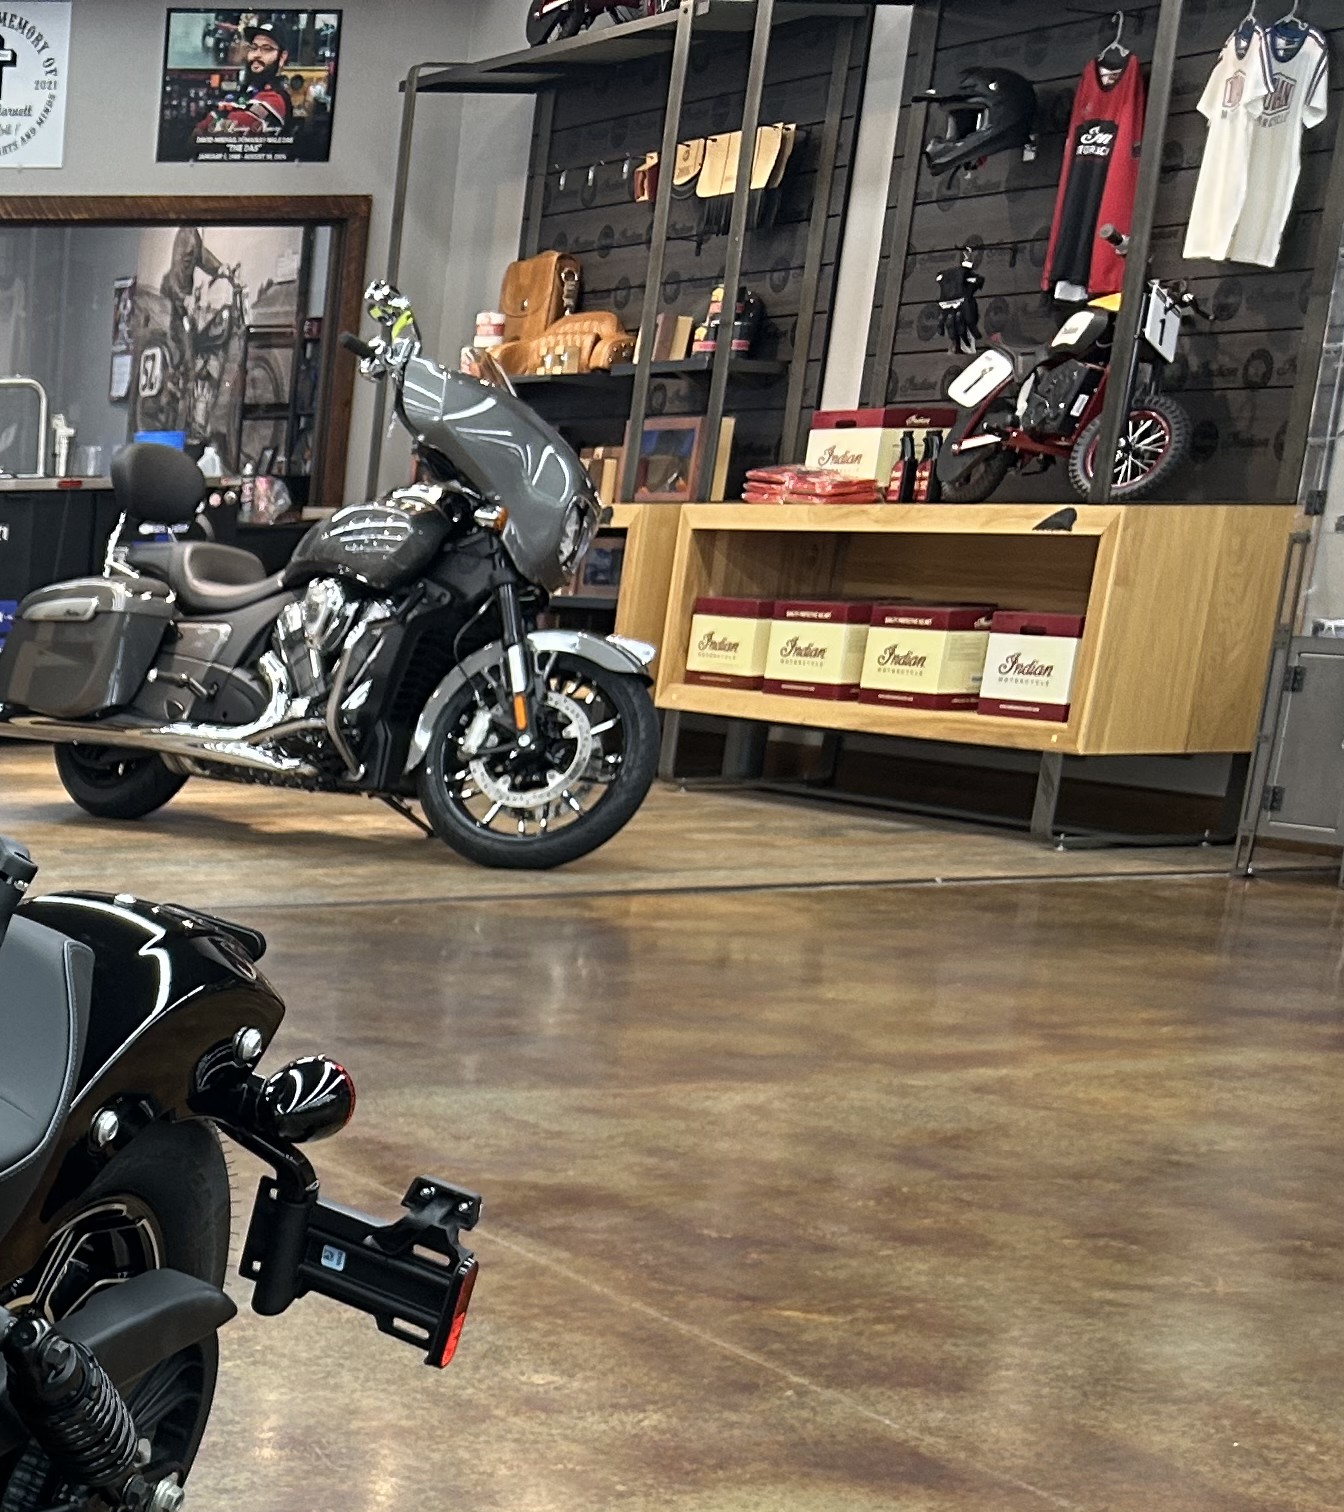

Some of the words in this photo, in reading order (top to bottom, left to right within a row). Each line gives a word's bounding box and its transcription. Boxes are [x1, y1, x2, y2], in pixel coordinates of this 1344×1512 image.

[42, 57, 58, 77] OF
[817, 444, 862, 467] Indian
[698, 630, 740, 653] Indian
[779, 635, 828, 660] Indian
[877, 644, 927, 669] Indian
[998, 652, 1054, 678] Indian
